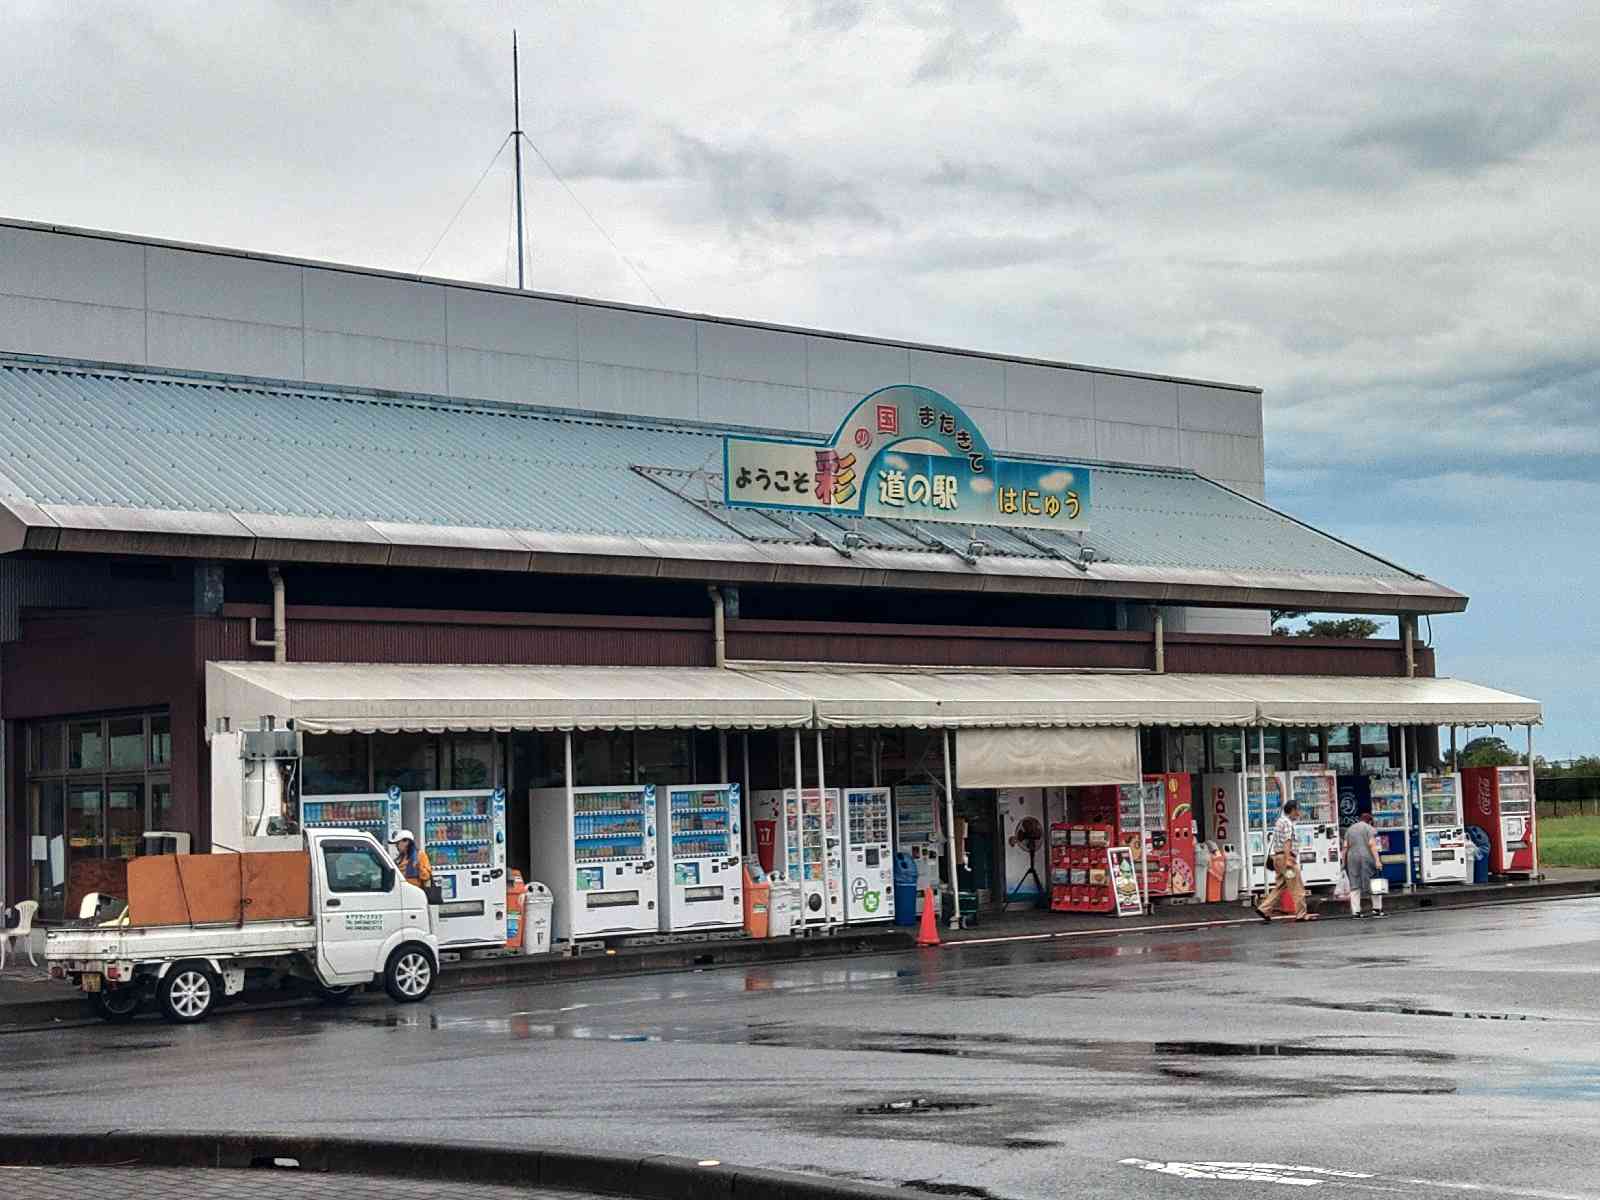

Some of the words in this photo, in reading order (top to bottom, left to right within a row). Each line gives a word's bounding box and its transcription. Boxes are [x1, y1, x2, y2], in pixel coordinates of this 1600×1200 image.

[918, 405, 985, 473] またきて
[735, 466, 811, 494] ようこそ
[878, 470, 960, 511] 道の駅
[999, 486, 1081, 518] はにゅう
